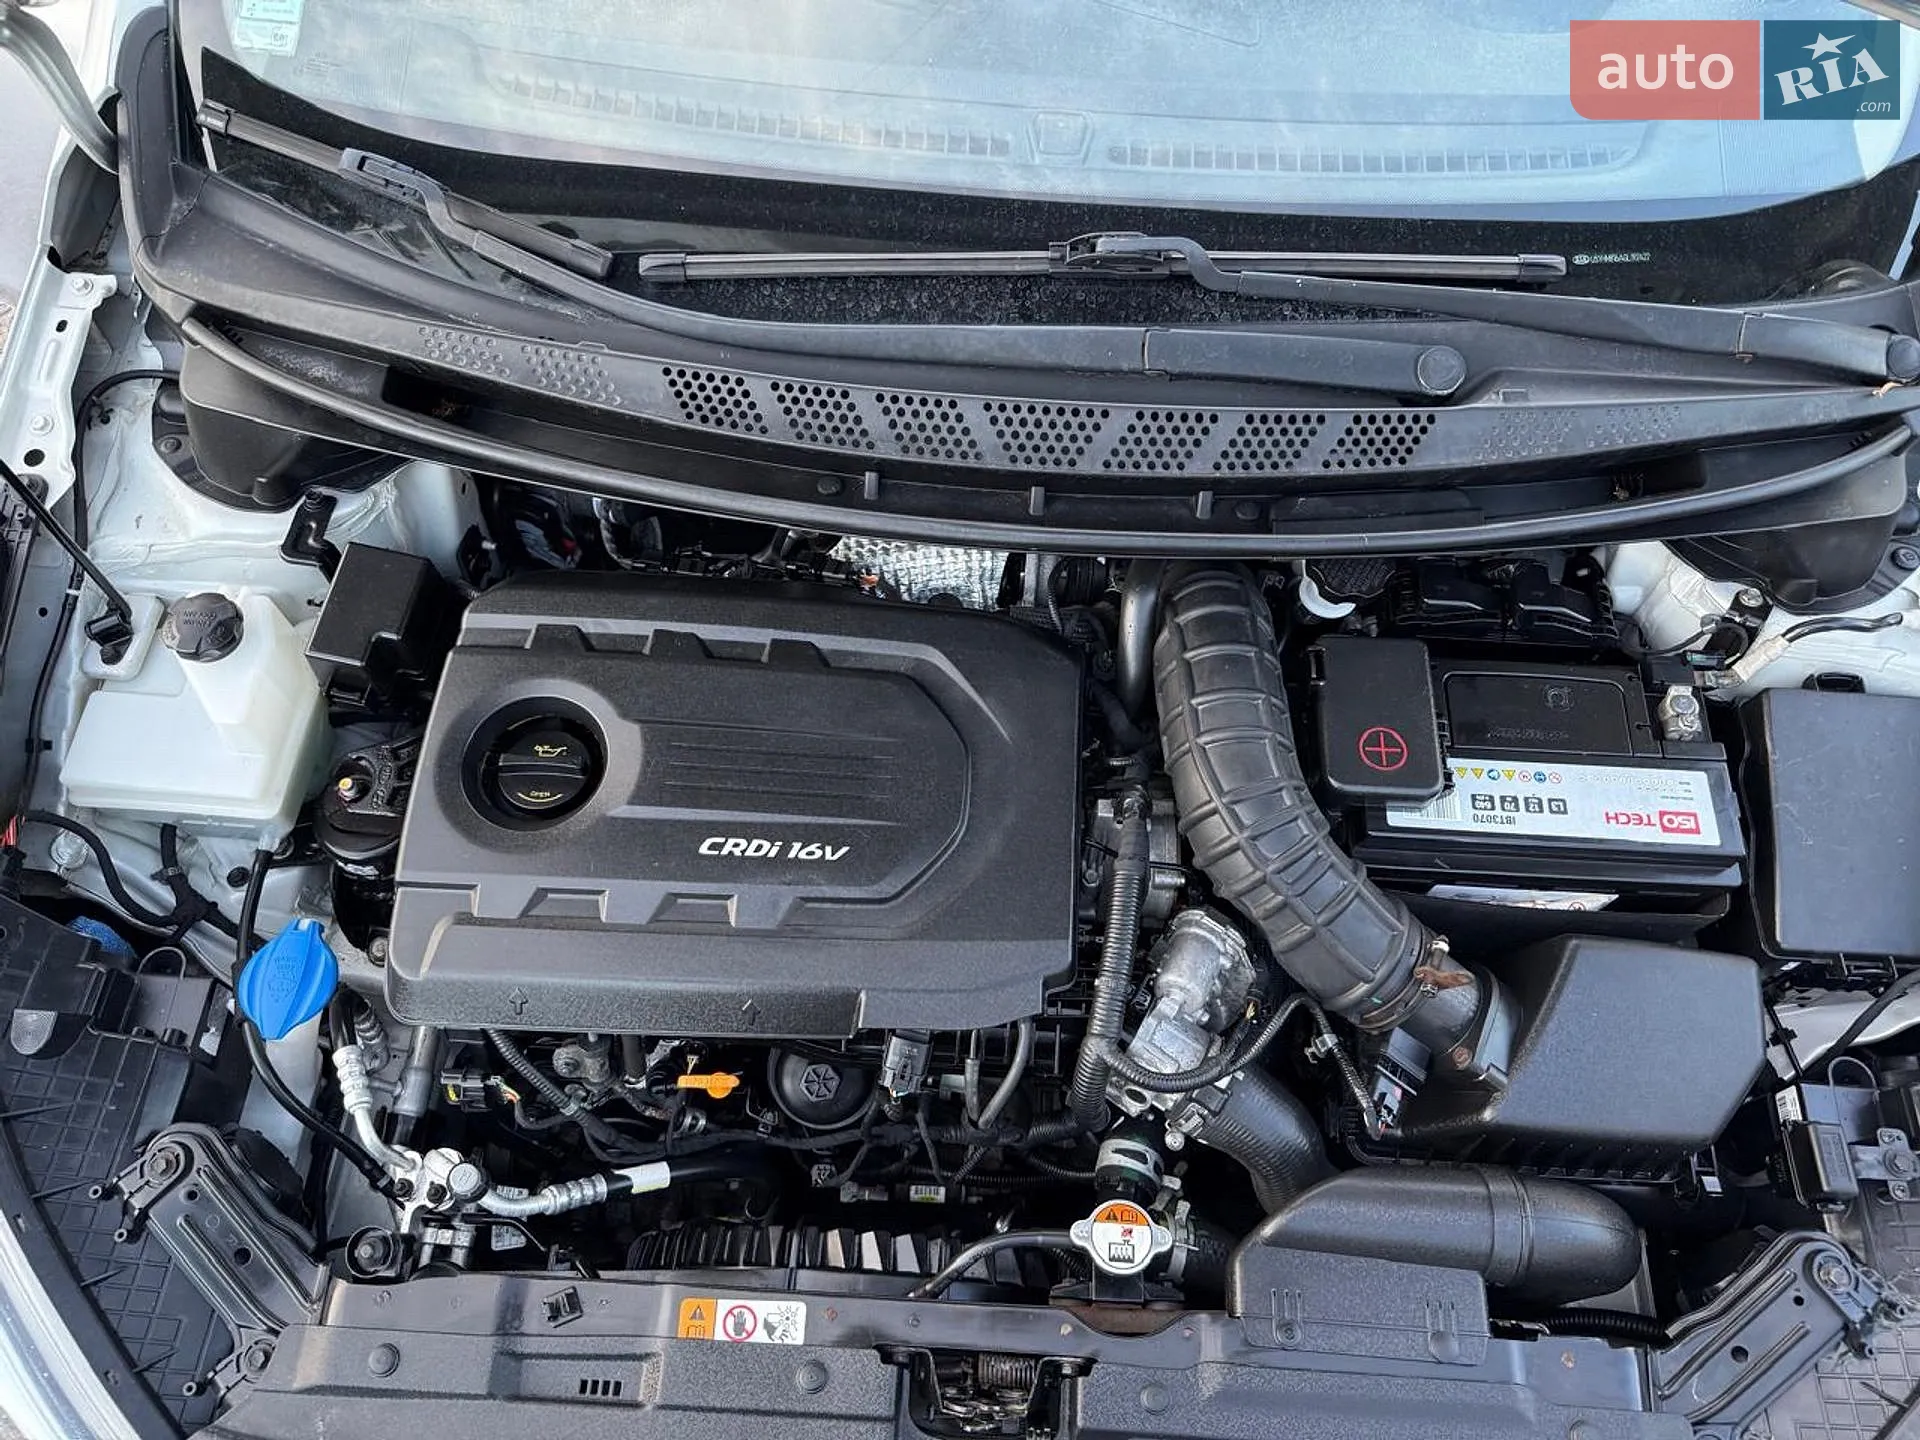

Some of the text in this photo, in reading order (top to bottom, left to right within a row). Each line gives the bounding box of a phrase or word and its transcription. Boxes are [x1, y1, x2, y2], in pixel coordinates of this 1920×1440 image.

[1473, 813, 1516, 825] IBT3070
[1605, 812, 1696, 829] ISO TECH
[698, 837, 850, 861] CRDi 16V
